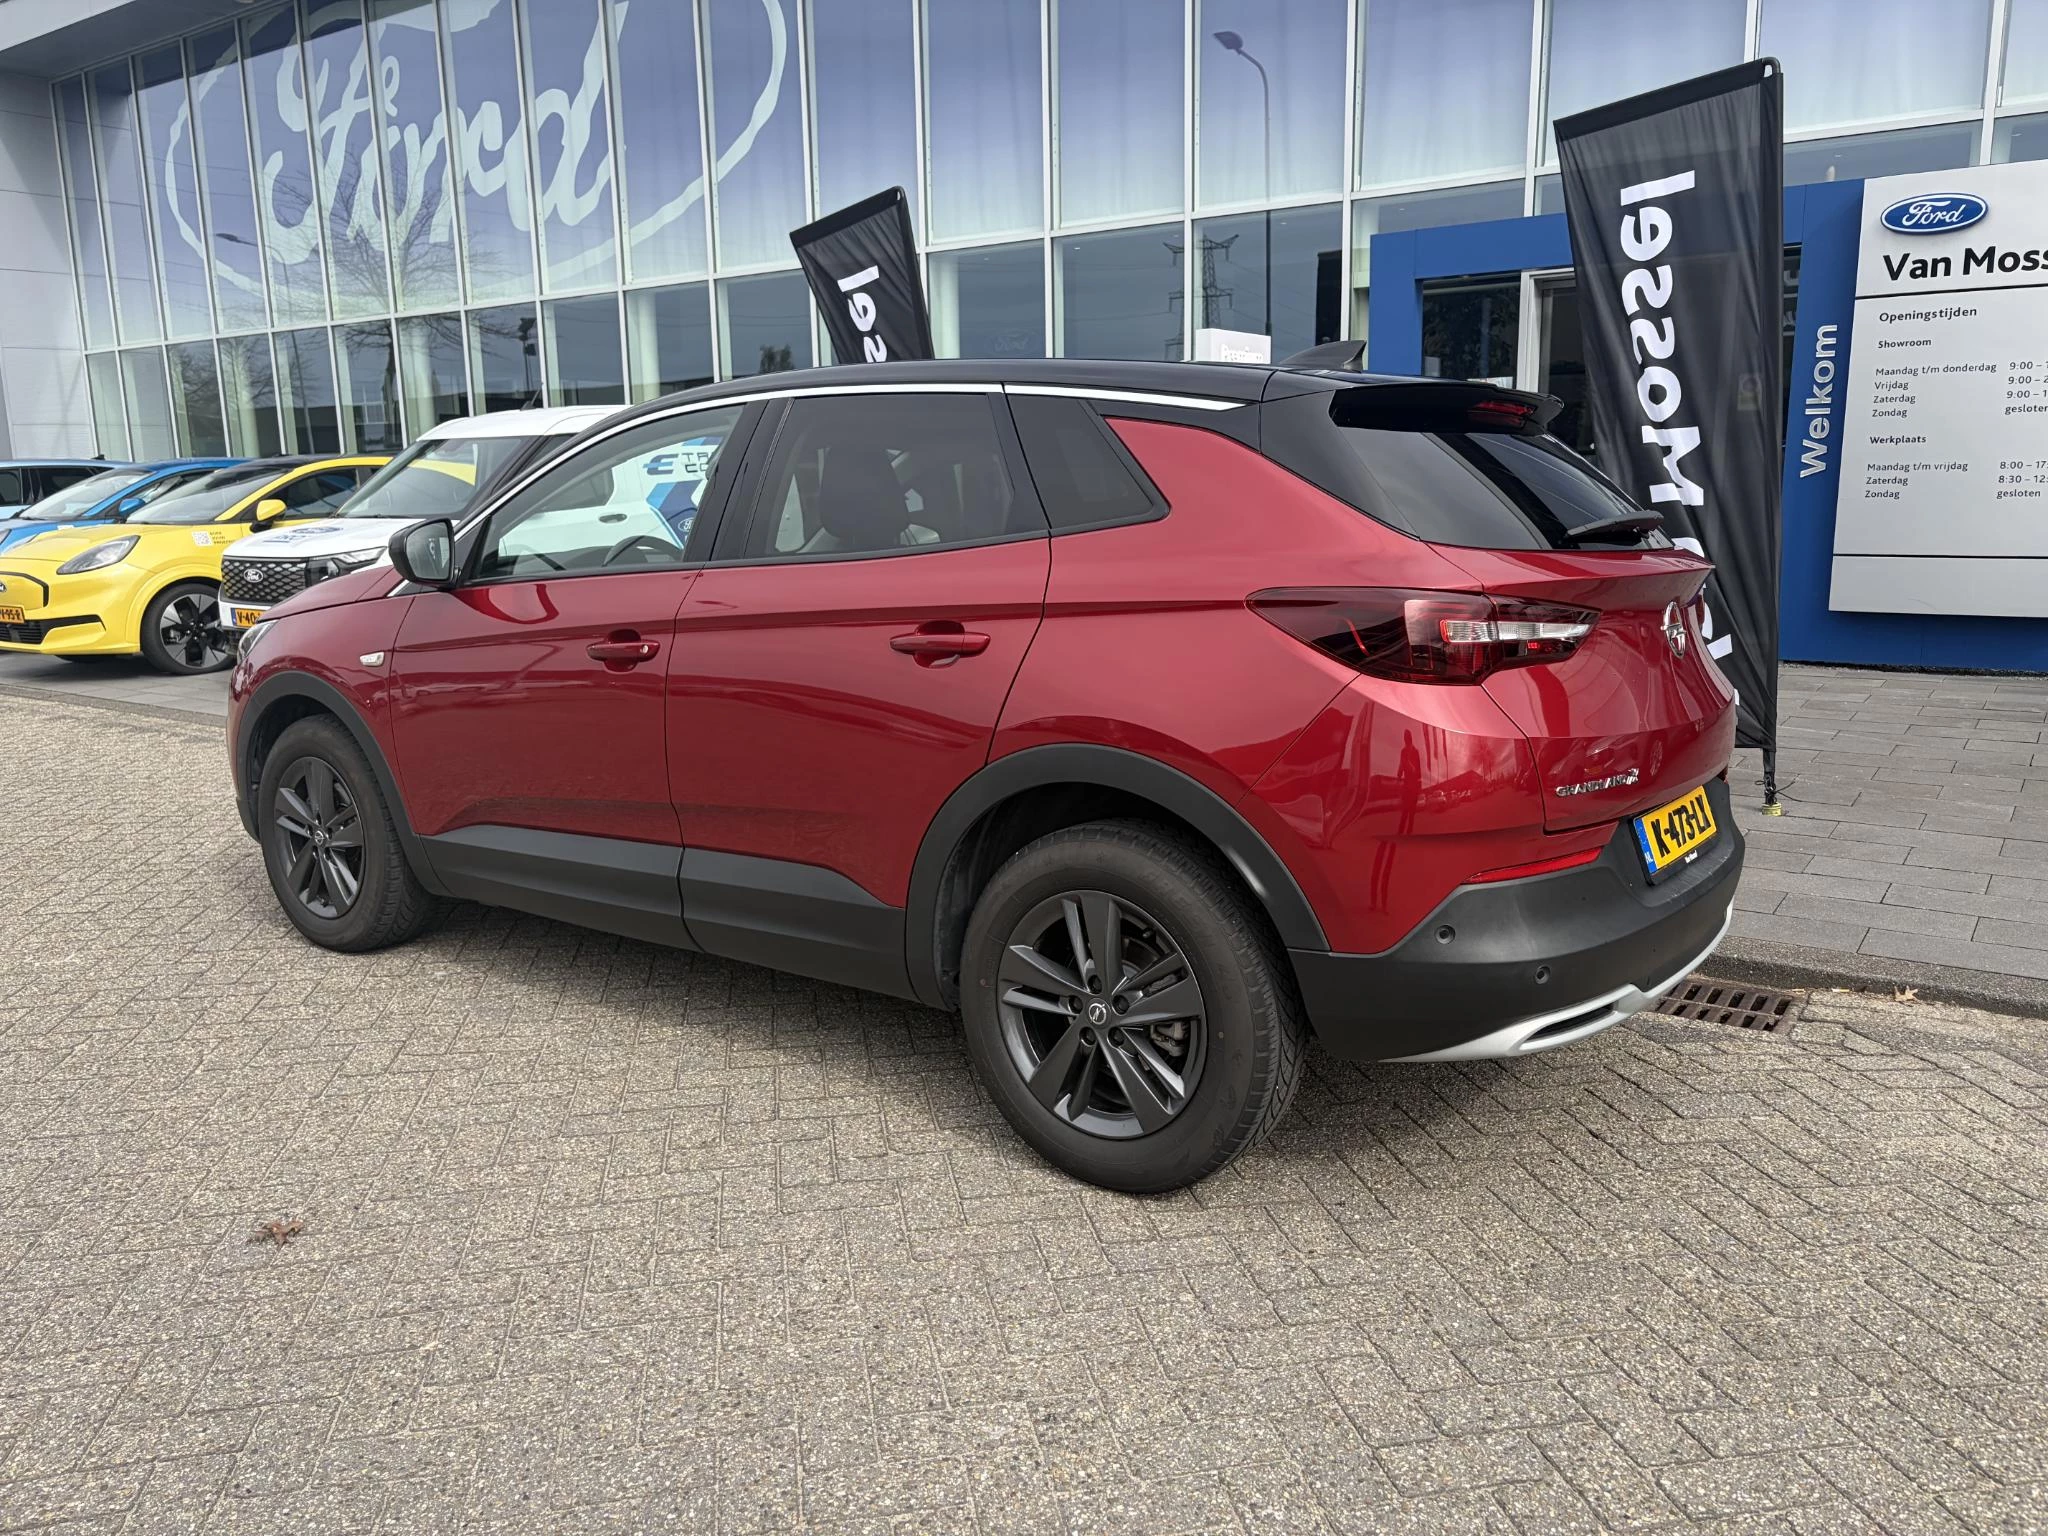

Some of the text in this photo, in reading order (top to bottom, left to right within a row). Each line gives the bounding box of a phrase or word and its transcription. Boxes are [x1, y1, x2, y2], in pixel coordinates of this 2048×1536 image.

[1902, 200, 1966, 226] Ford
[1883, 252, 1952, 281] Van
[1879, 306, 1977, 324] Openingstijden
[1877, 338, 1932, 349] Showroom
[1875, 366, 1919, 376] Maandag
[1921, 365, 1940, 374] t/m
[1942, 362, 1997, 373] donderdag
[2009, 361, 2033, 370] 9:00
[1874, 380, 1909, 391] Vrijdag
[2008, 375, 2032, 384] 9:00
[1799, 324, 1838, 478] Welkom
[1873, 394, 1916, 405] Zaterdag
[2006, 390, 2031, 399] 9:00
[1872, 408, 1908, 419] Zondag
[1869, 435, 1927, 445] Werkplaats
[1867, 462, 1910, 473] Maandag
[1913, 462, 1931, 471] t/m
[1934, 461, 1969, 472] vrijdag
[1999, 461, 2023, 470] 8:00
[1866, 476, 1909, 486] Zaterdag
[1998, 475, 2022, 484] 8:30
[1864, 488, 2041, 500] Zondag gesloten
[1650, 794, 1712, 859] K-473-LX
